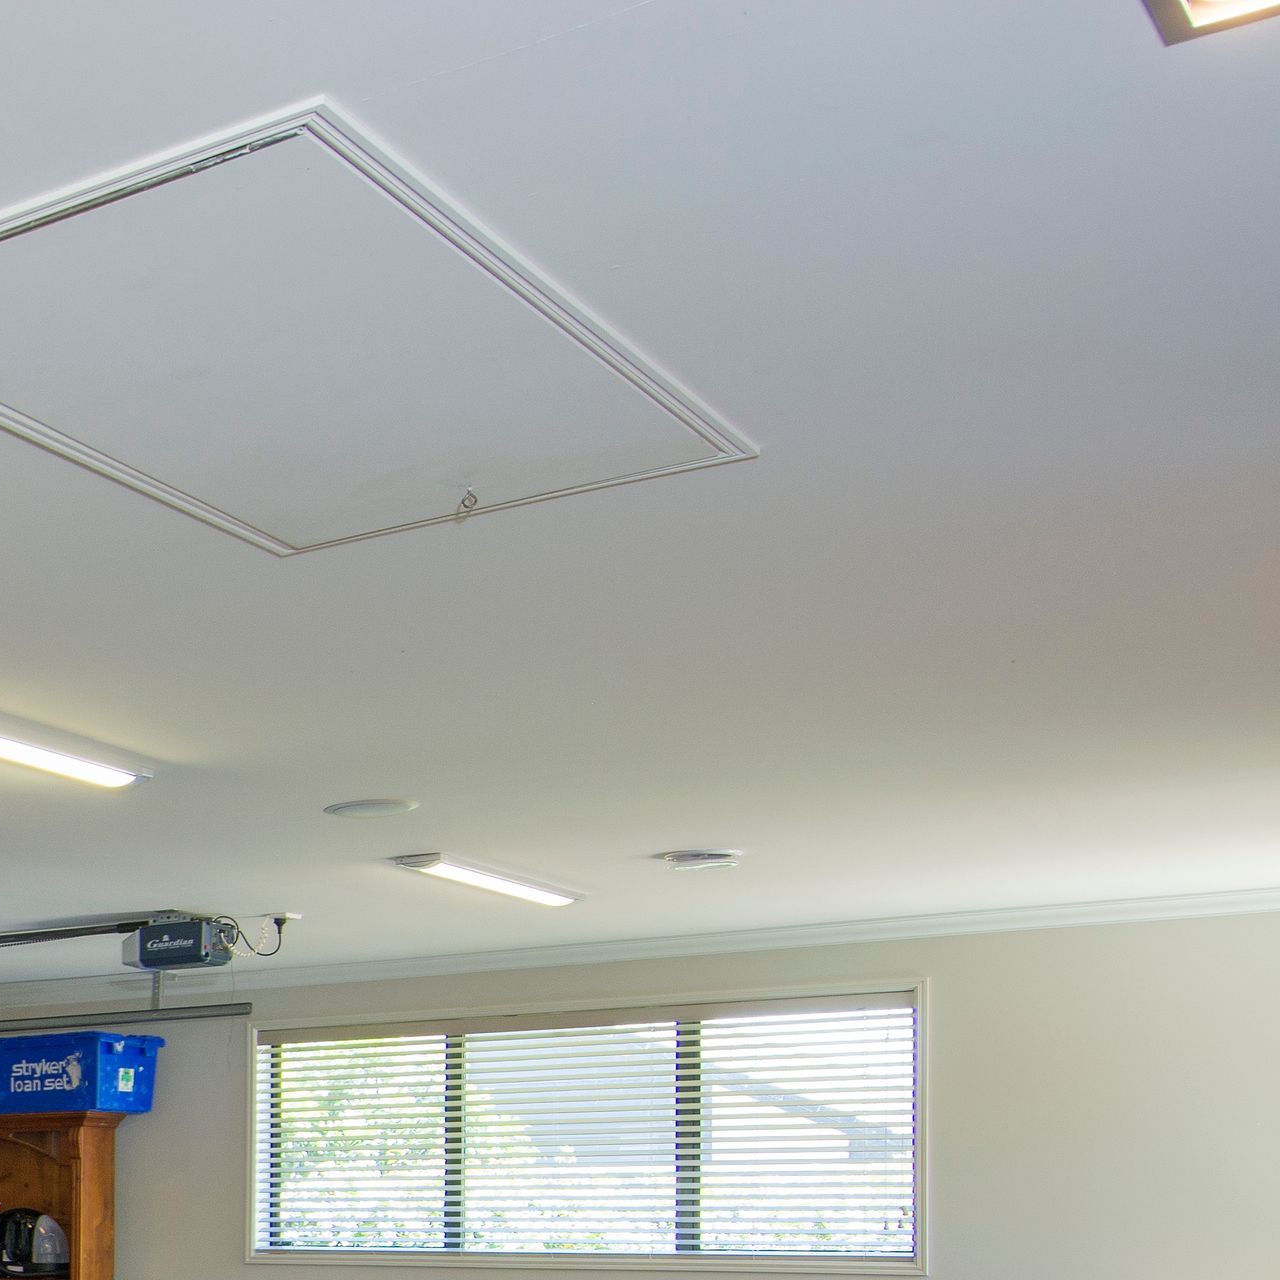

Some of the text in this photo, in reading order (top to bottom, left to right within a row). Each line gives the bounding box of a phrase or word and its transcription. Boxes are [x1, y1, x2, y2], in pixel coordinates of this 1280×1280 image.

[147, 938, 193, 949] Guardian
[11, 1059, 66, 1077] stryker
[10, 1074, 73, 1092] loan set
